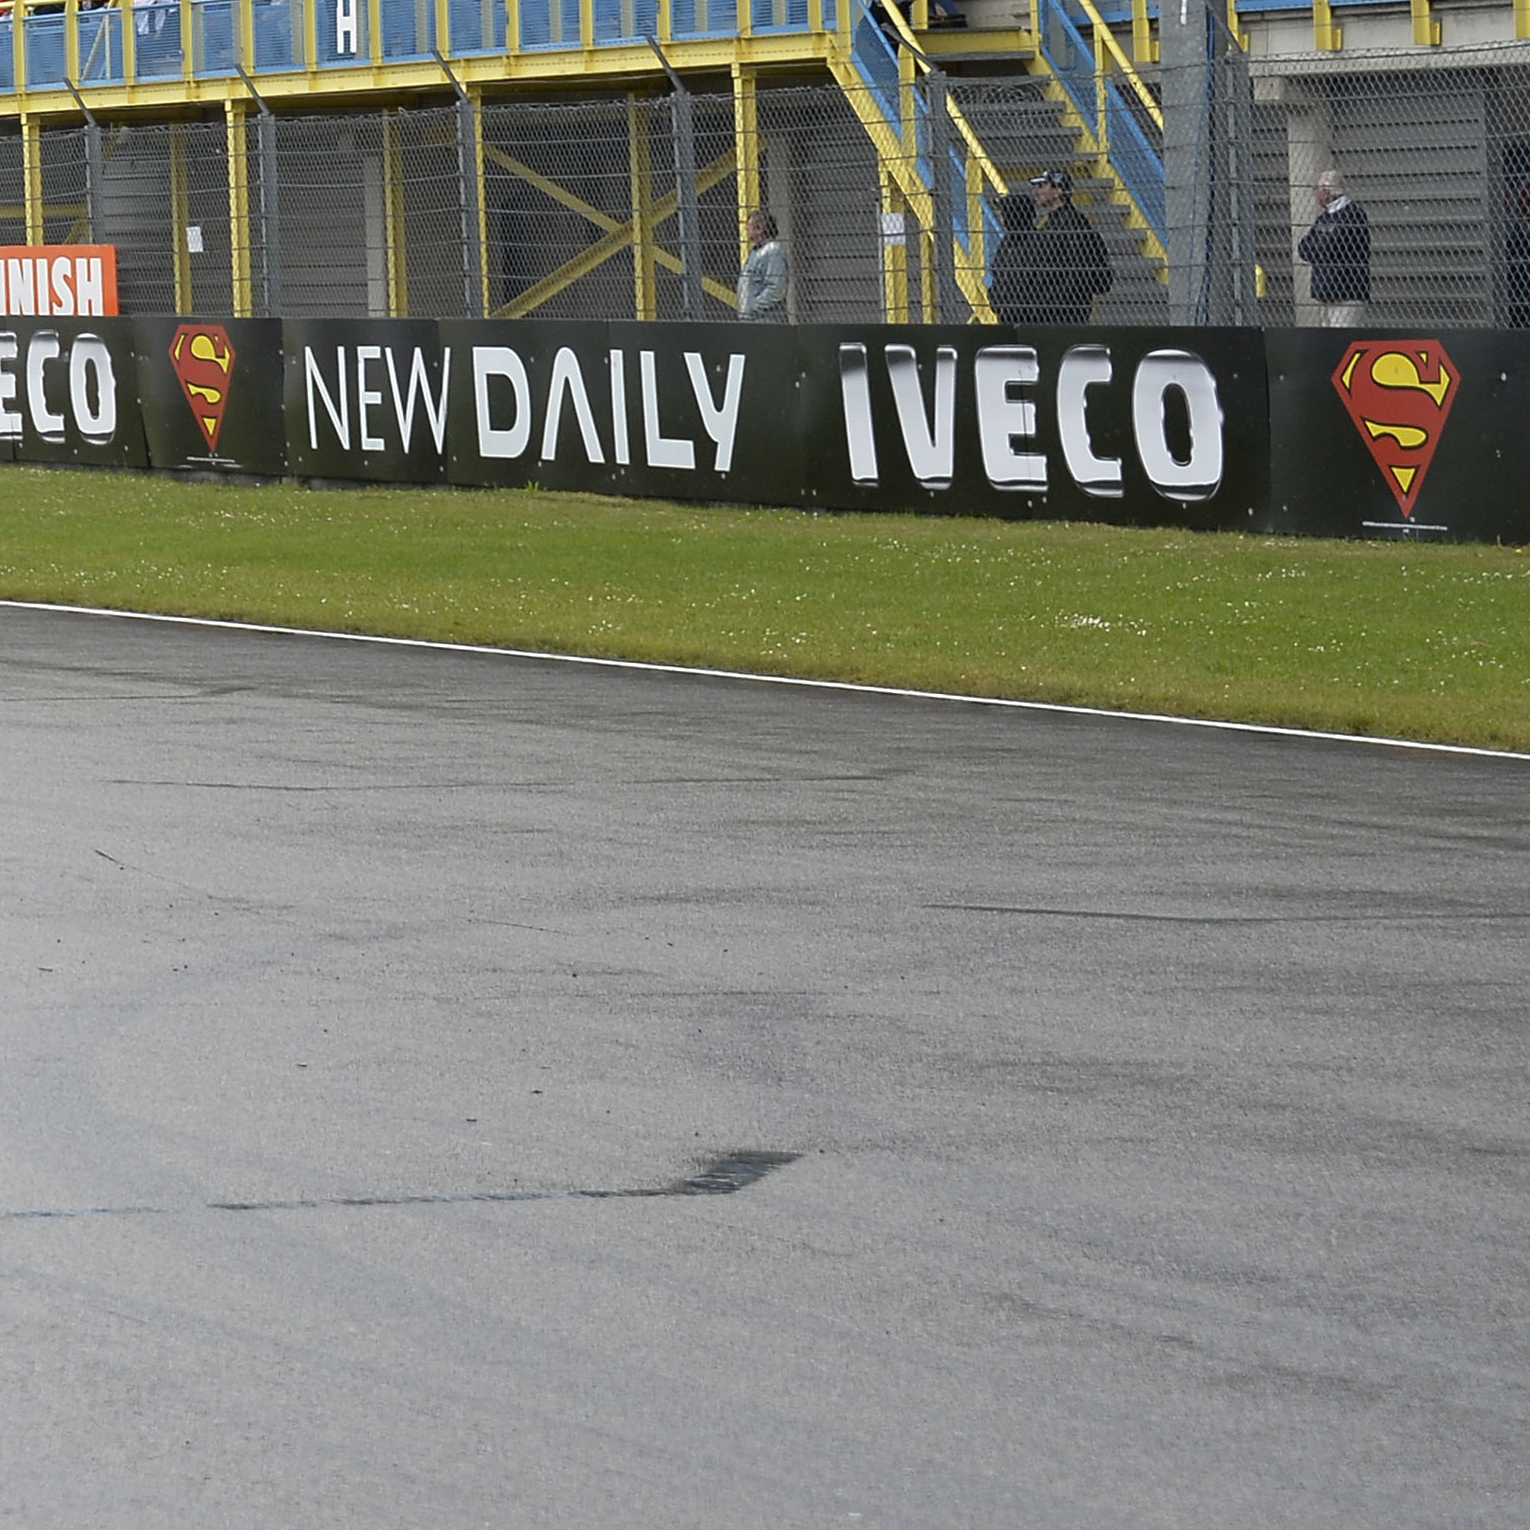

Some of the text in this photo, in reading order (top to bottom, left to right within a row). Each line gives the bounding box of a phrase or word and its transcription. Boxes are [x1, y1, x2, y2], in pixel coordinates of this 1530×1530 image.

[304, 342, 1224, 502] NEW DAILY IVECO
